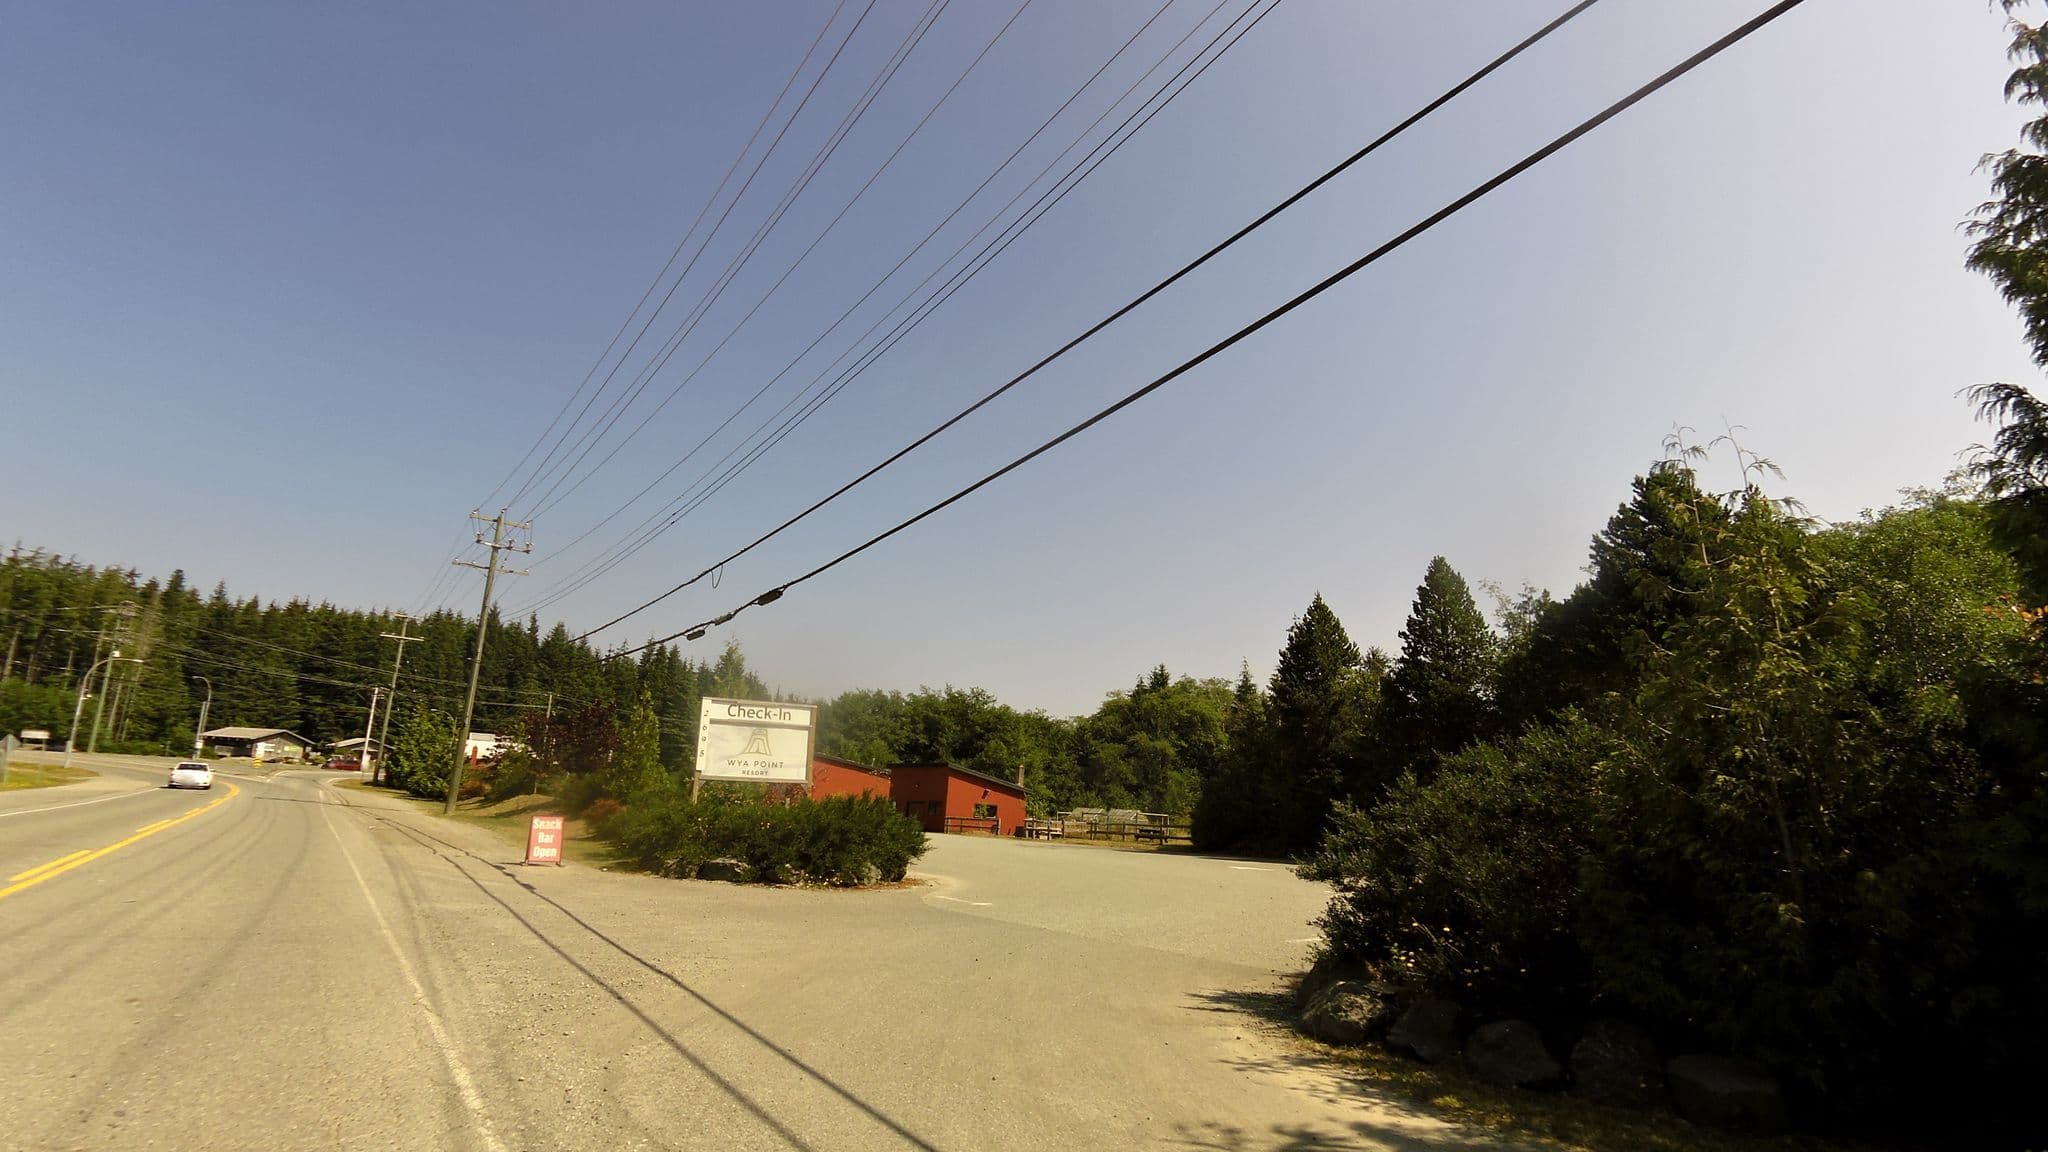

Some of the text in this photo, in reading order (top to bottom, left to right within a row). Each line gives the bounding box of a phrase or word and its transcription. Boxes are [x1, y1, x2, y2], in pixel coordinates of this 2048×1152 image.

[727, 704, 791, 721] Check-In
[727, 759, 785, 769] WYA POINT
[533, 818, 562, 830] Snack
[538, 832, 555, 844] Bar
[533, 845, 558, 859] Open
